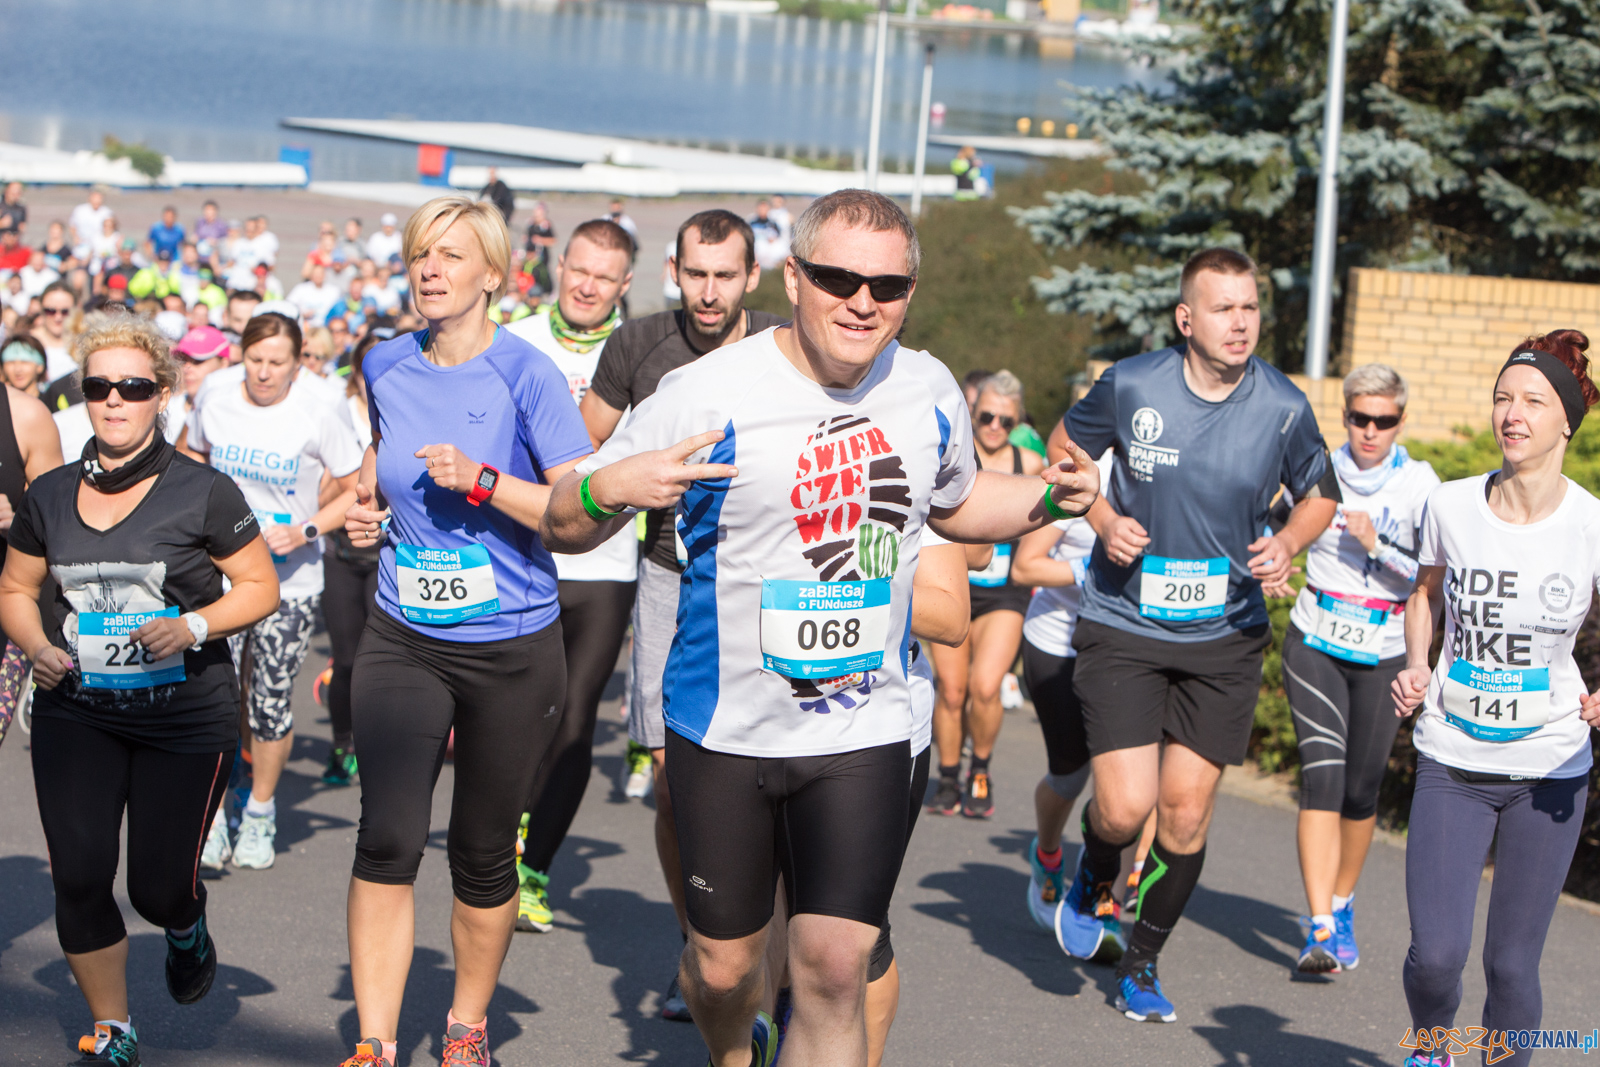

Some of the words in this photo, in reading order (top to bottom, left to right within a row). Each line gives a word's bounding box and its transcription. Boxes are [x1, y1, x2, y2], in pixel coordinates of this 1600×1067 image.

[1129, 445, 1180, 467] SPARTAN
[1129, 457, 1155, 475] RACE
[790, 464, 866, 509] CZE
[793, 502, 862, 544] WO
[416, 550, 461, 563] zaBIEGaj
[422, 561, 462, 571] FUNdusze
[418, 577, 468, 602] 326
[798, 584, 866, 599] zaBIEGaj
[1164, 583, 1206, 602] 208
[798, 602, 806, 610] o
[809, 600, 864, 610] FUNdusze
[1449, 593, 1504, 629] THE
[798, 618, 861, 651] 068
[1330, 621, 1364, 644] 123
[105, 643, 156, 666] 228
[1453, 622, 1532, 666] BIKE
[1470, 670, 1523, 685] zaBIEGaj
[1477, 682, 1523, 692] FUNdusze
[1469, 695, 1518, 721] 141
